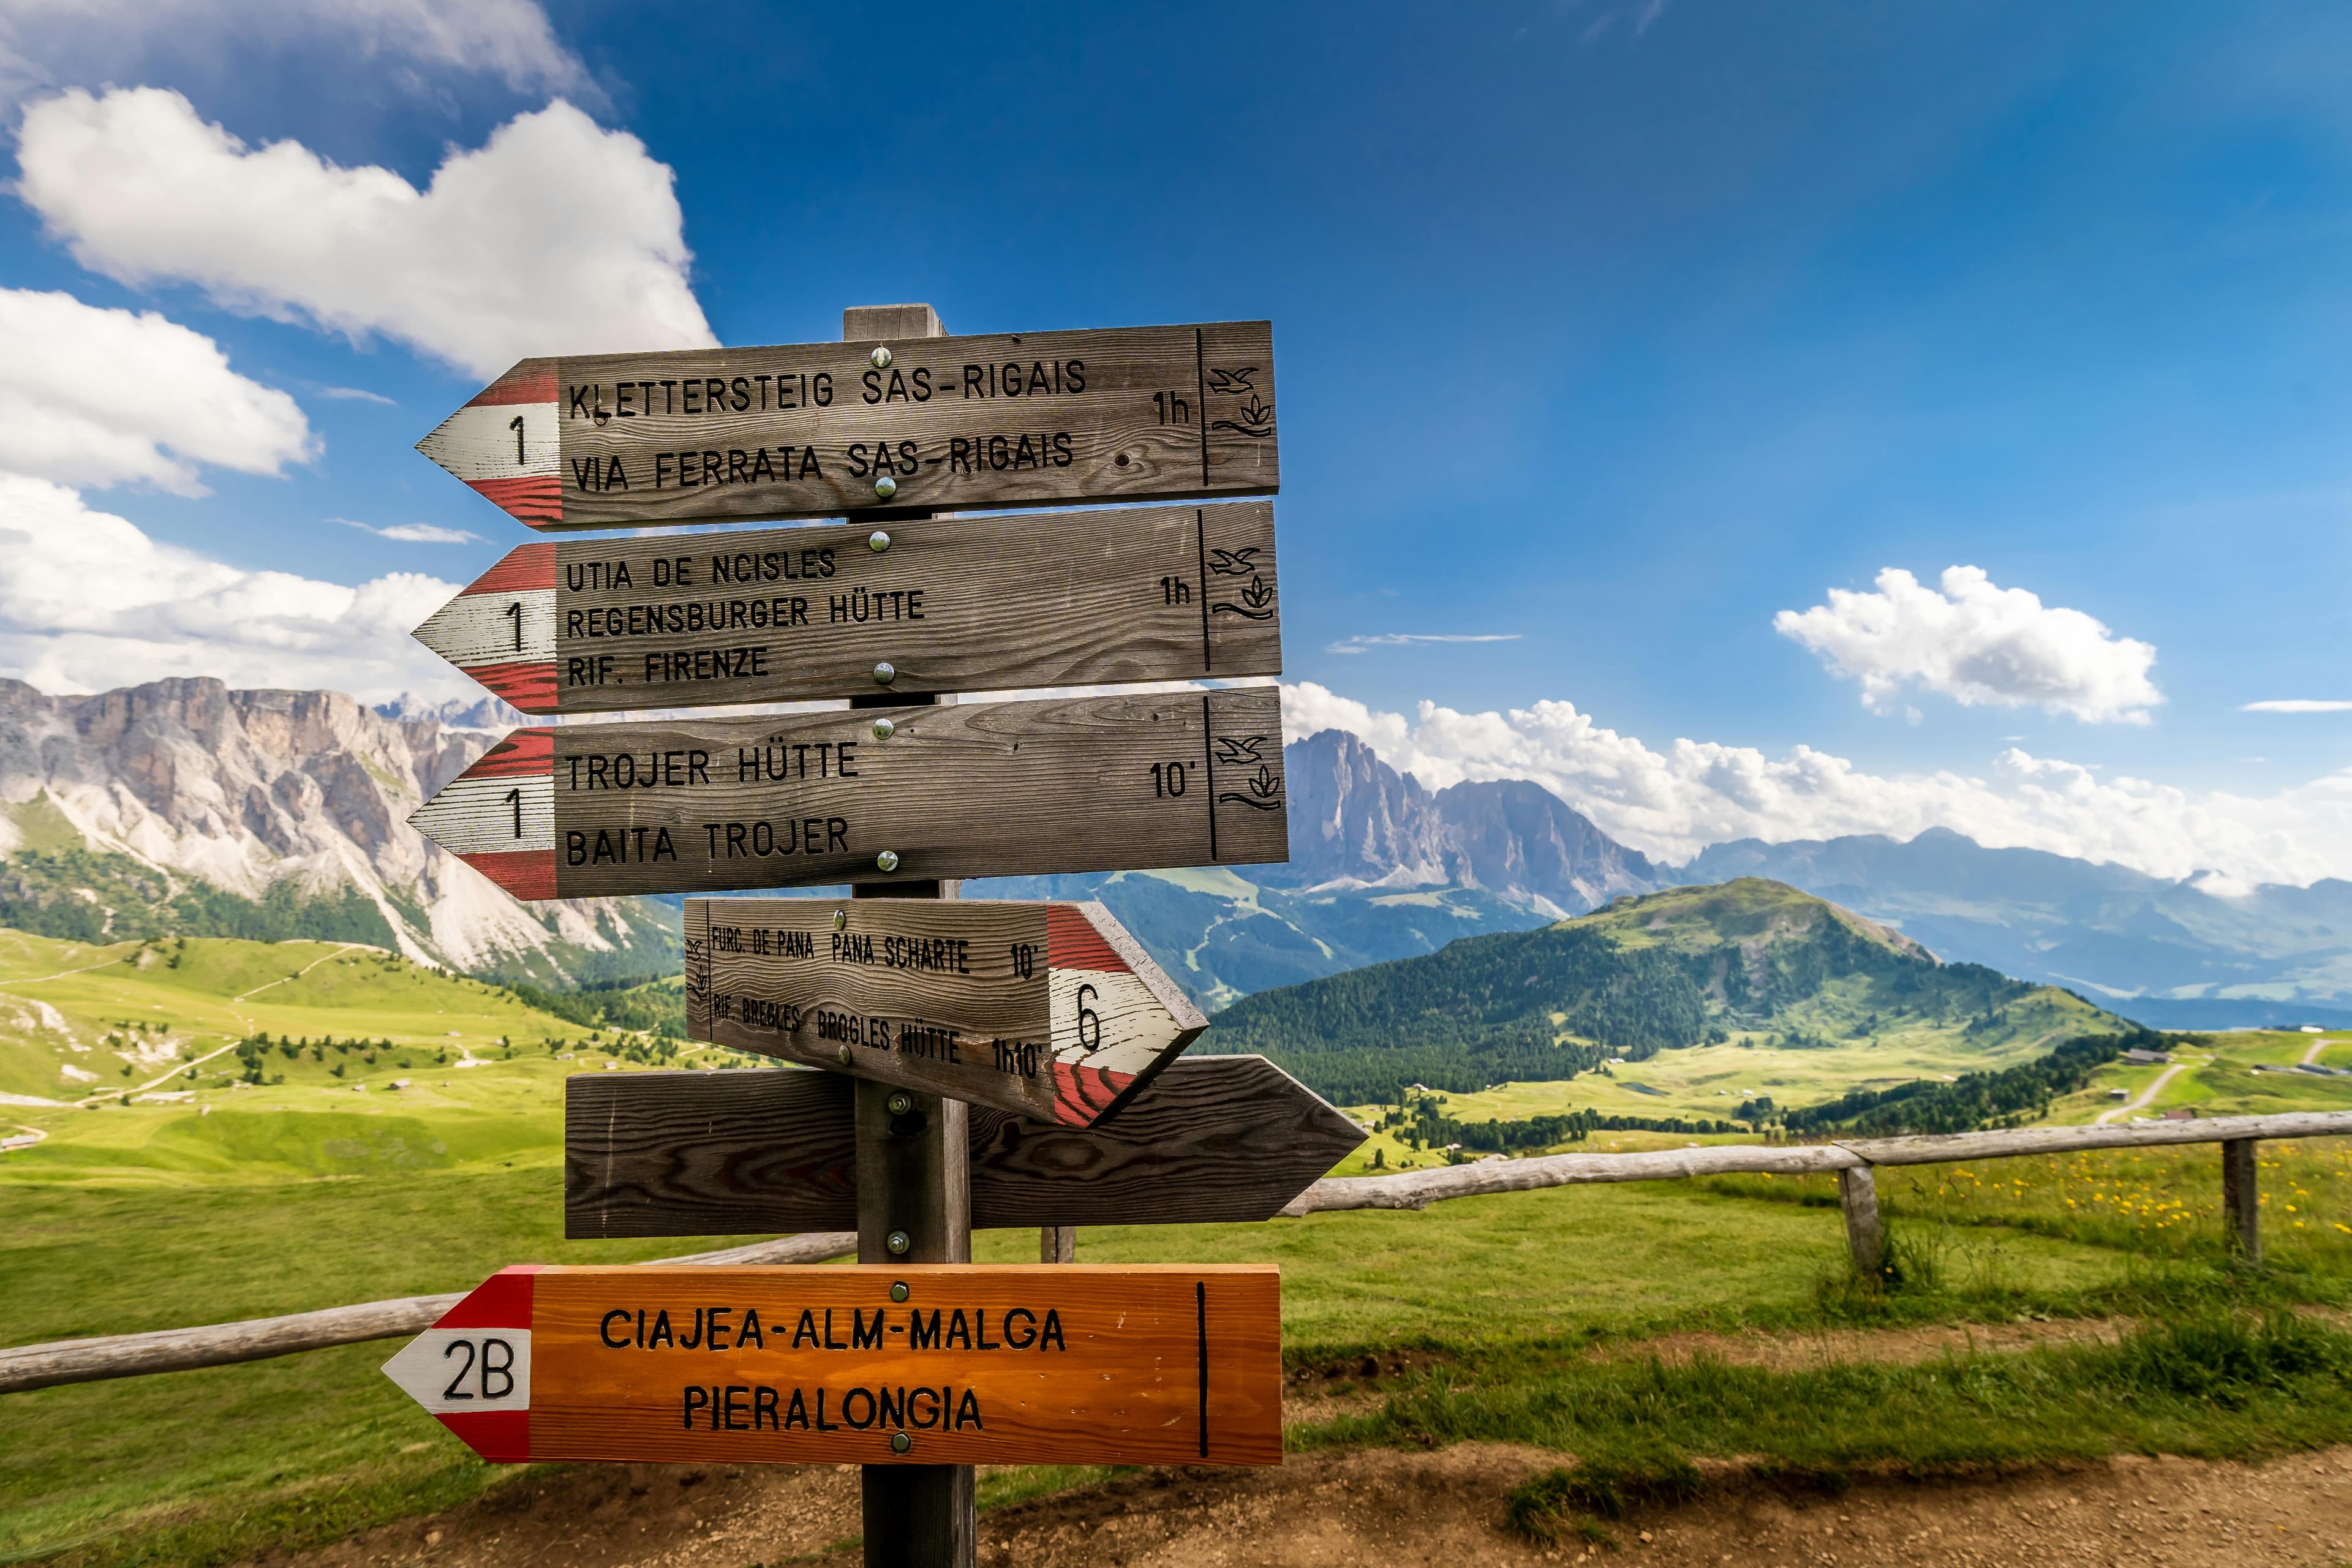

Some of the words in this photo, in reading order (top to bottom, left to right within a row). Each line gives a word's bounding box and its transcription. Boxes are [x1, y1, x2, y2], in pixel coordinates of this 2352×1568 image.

[570, 372, 833, 419] KLETTERSTEIG
[862, 360, 1086, 405] SAS-RIGAIS
[1153, 391, 1189, 425] 1h
[509, 416, 524, 466] 1
[571, 456, 628, 491] VIA
[655, 445, 823, 488] FERRATA
[848, 432, 1073, 478] SAS-RIGAIS
[567, 560, 633, 592] UTIA
[654, 557, 692, 587] DE
[712, 549, 836, 584] NCISLES
[1160, 576, 1189, 605] 1h
[507, 602, 522, 652] 1
[568, 597, 809, 639] REGENSBURGER
[830, 587, 925, 623] HÜTTE
[568, 656, 623, 687] RIF.
[646, 647, 769, 682] FIRENZE
[565, 749, 710, 790] TROJER
[739, 736, 858, 782] HÜTTE
[504, 788, 521, 839] 1
[566, 826, 677, 867] BAITA
[703, 817, 849, 859] TROJER
[712, 927, 745, 953] FURC.
[753, 929, 770, 955] DE
[778, 930, 814, 959] PANA
[832, 933, 874, 965] PANA
[884, 936, 970, 974] SCHARTE
[714, 993, 734, 1020] RIF.
[742, 998, 800, 1033] BREGLES
[818, 1009, 889, 1050] BROGLES
[901, 1018, 960, 1065] HÜTTE
[1077, 984, 1100, 1051] 6
[600, 1308, 1066, 1351] CIAJEA-ALM-MALGA
[443, 1339, 514, 1401] 2B
[684, 1387, 982, 1430] PIERALONGIA
